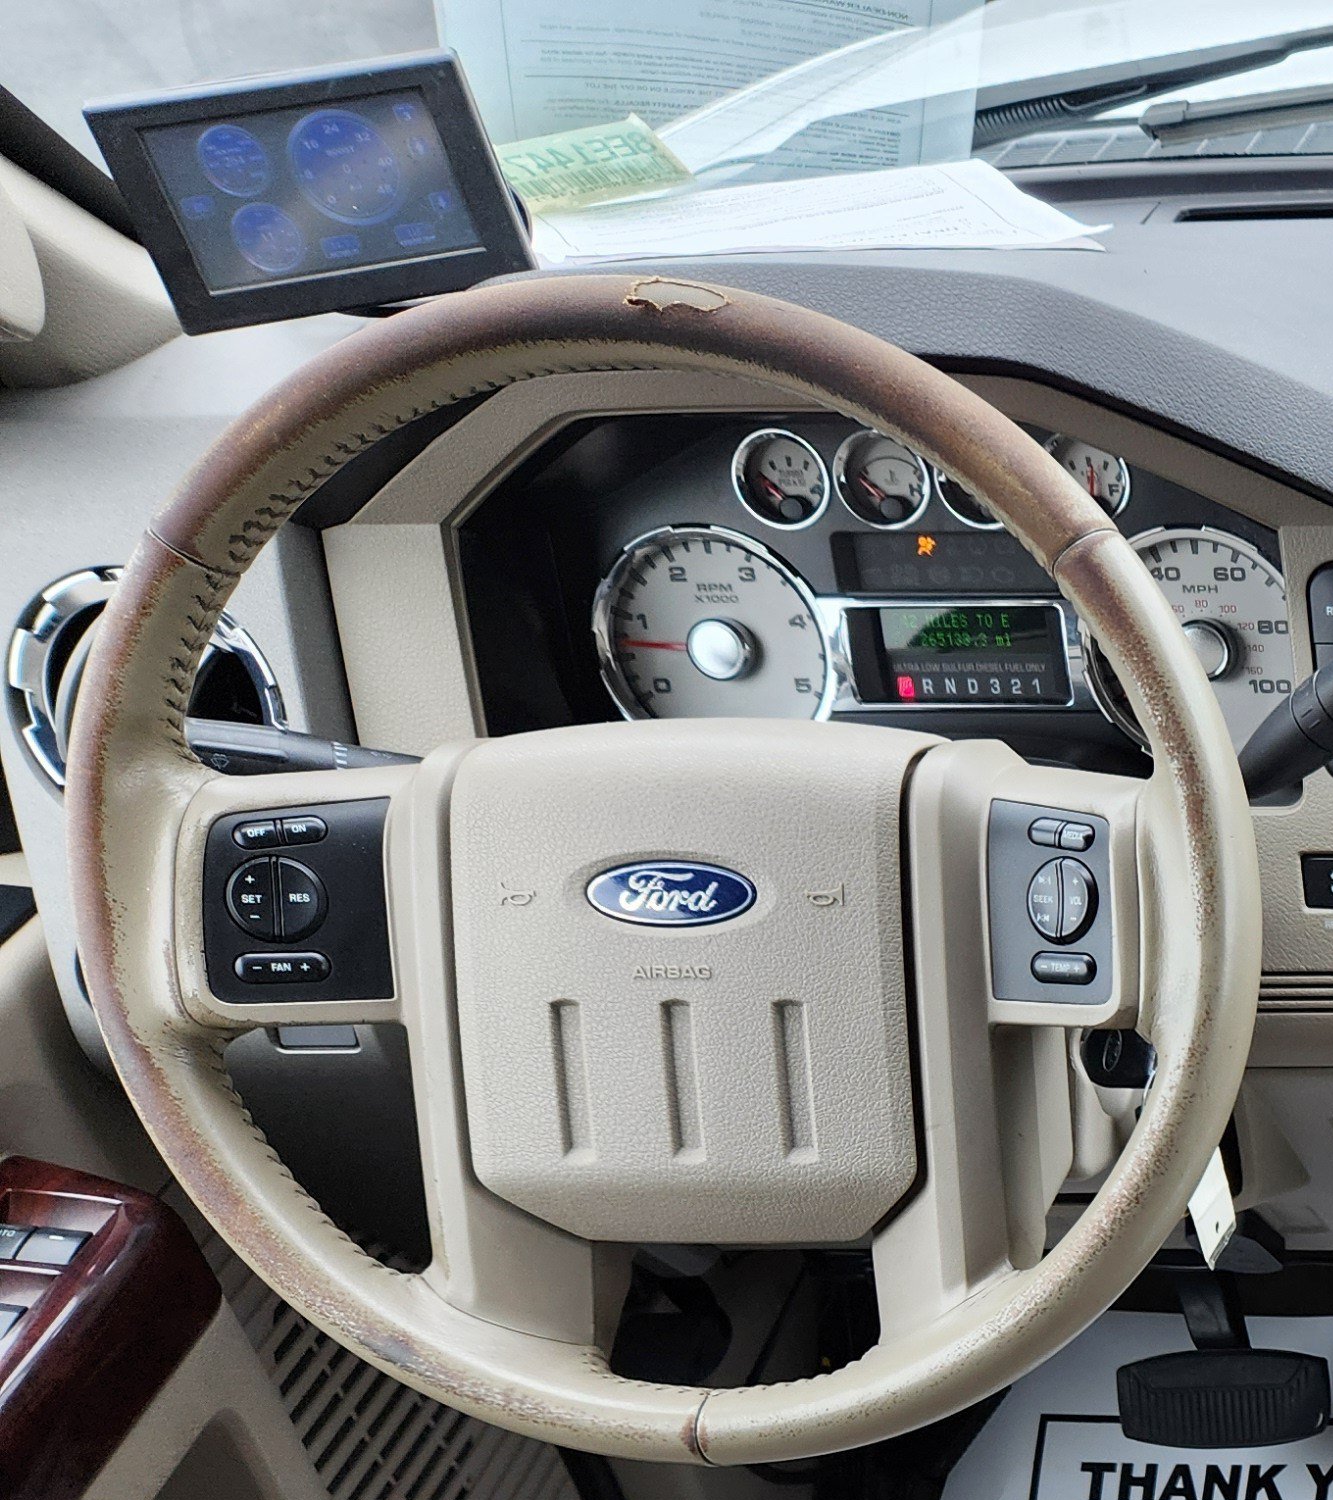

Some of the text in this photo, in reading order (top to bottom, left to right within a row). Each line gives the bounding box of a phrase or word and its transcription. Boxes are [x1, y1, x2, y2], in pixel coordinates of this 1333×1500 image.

[669, 566, 688, 582] 2
[738, 567, 756, 582] 3
[1213, 567, 1246, 581] 60
[695, 583, 733, 592] RPM
[1182, 584, 1218, 594] MPH
[637, 613, 648, 630] 1
[788, 614, 807, 630] 4
[1257, 620, 1289, 635] 80
[653, 678, 671, 694] 0
[794, 678, 812, 693] 5
[922, 678, 934, 694] R
[945, 678, 957, 694] N
[968, 678, 979, 694] D
[990, 678, 1000, 694] 3
[1011, 678, 1022, 694] 2
[1249, 679, 1292, 694] 100
[246, 823, 307, 839] OFF ON
[241, 893, 262, 904] SET
[289, 892, 311, 904] RES
[618, 870, 717, 915] Ford
[1033, 894, 1054, 904] SEEK
[1069, 895, 1082, 906] VOL
[271, 962, 292, 972] FAN
[633, 964, 713, 981] AIRBAG
